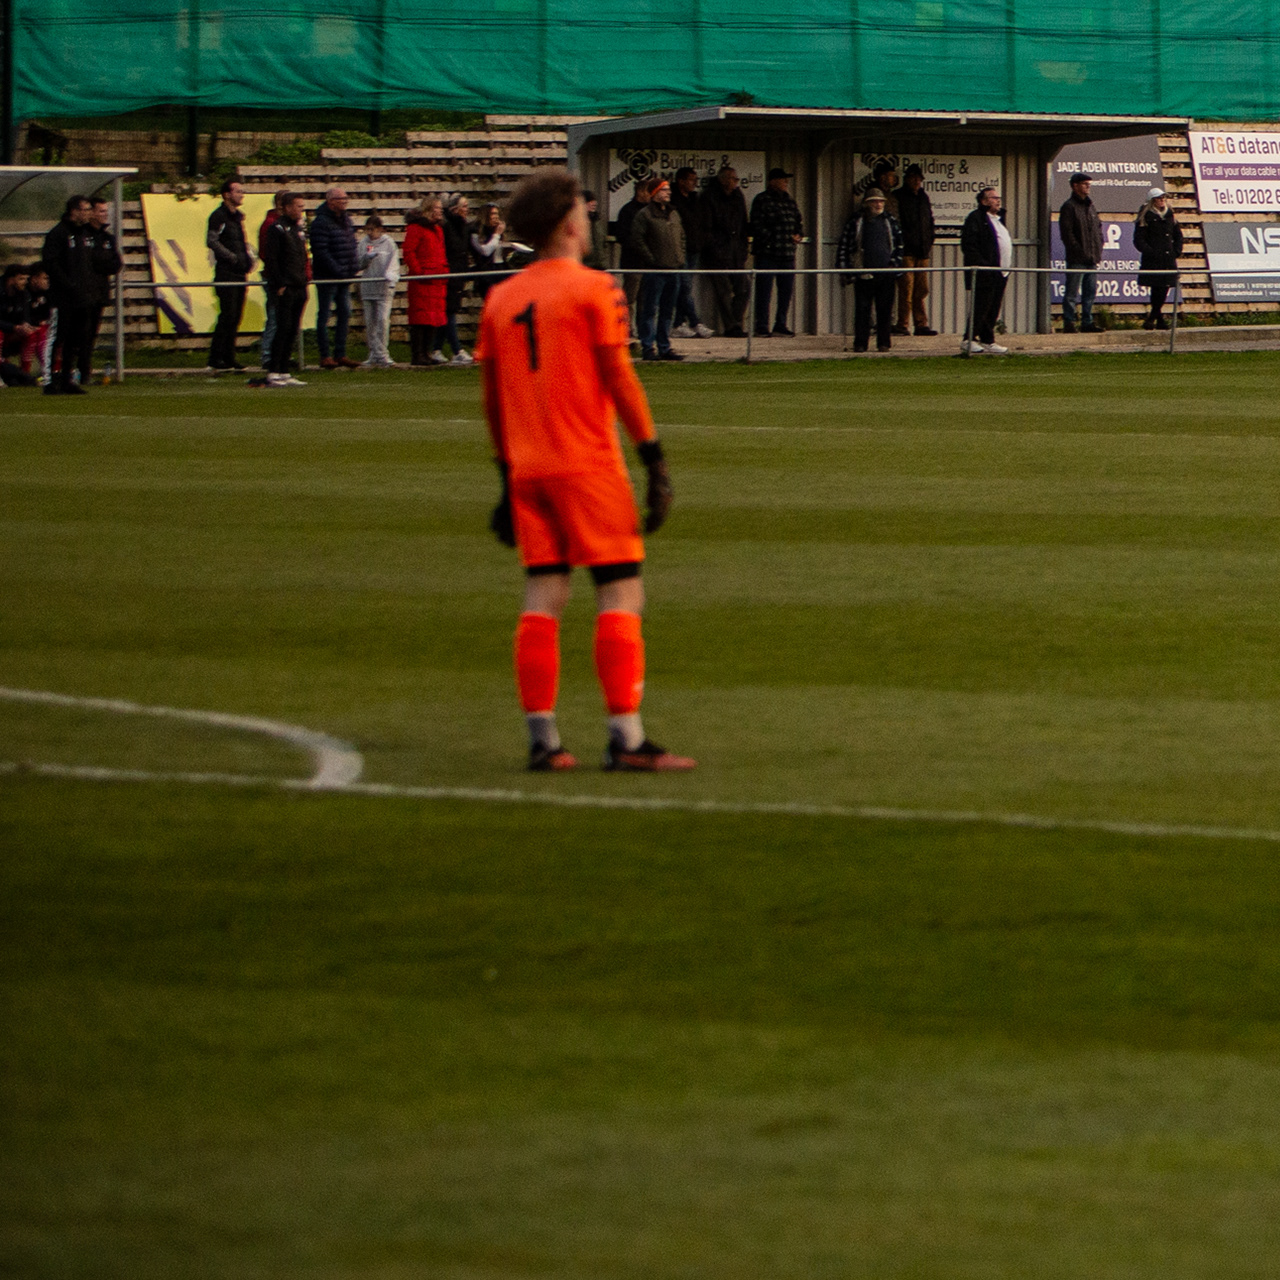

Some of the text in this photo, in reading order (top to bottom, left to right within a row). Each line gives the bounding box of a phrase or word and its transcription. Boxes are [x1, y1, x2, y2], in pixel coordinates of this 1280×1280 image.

[1201, 136, 1236, 155] AT&G
[660, 153, 716, 176] Building
[720, 154, 731, 170] &
[902, 157, 969, 179] Bilding &
[1057, 161, 1158, 174] JADE ADEN INTERIORS
[1202, 165, 1214, 176] For
[1215, 165, 1224, 176] all
[1224, 167, 1239, 178] your
[1240, 166, 1257, 176] data
[1257, 166, 1276, 177] cable
[985, 176, 999, 188] Ltd
[1124, 179, 1152, 187] Contractors
[1212, 188, 1234, 204] Tel:
[1235, 188, 1273, 205] 01202
[512, 300, 539, 373] 1
